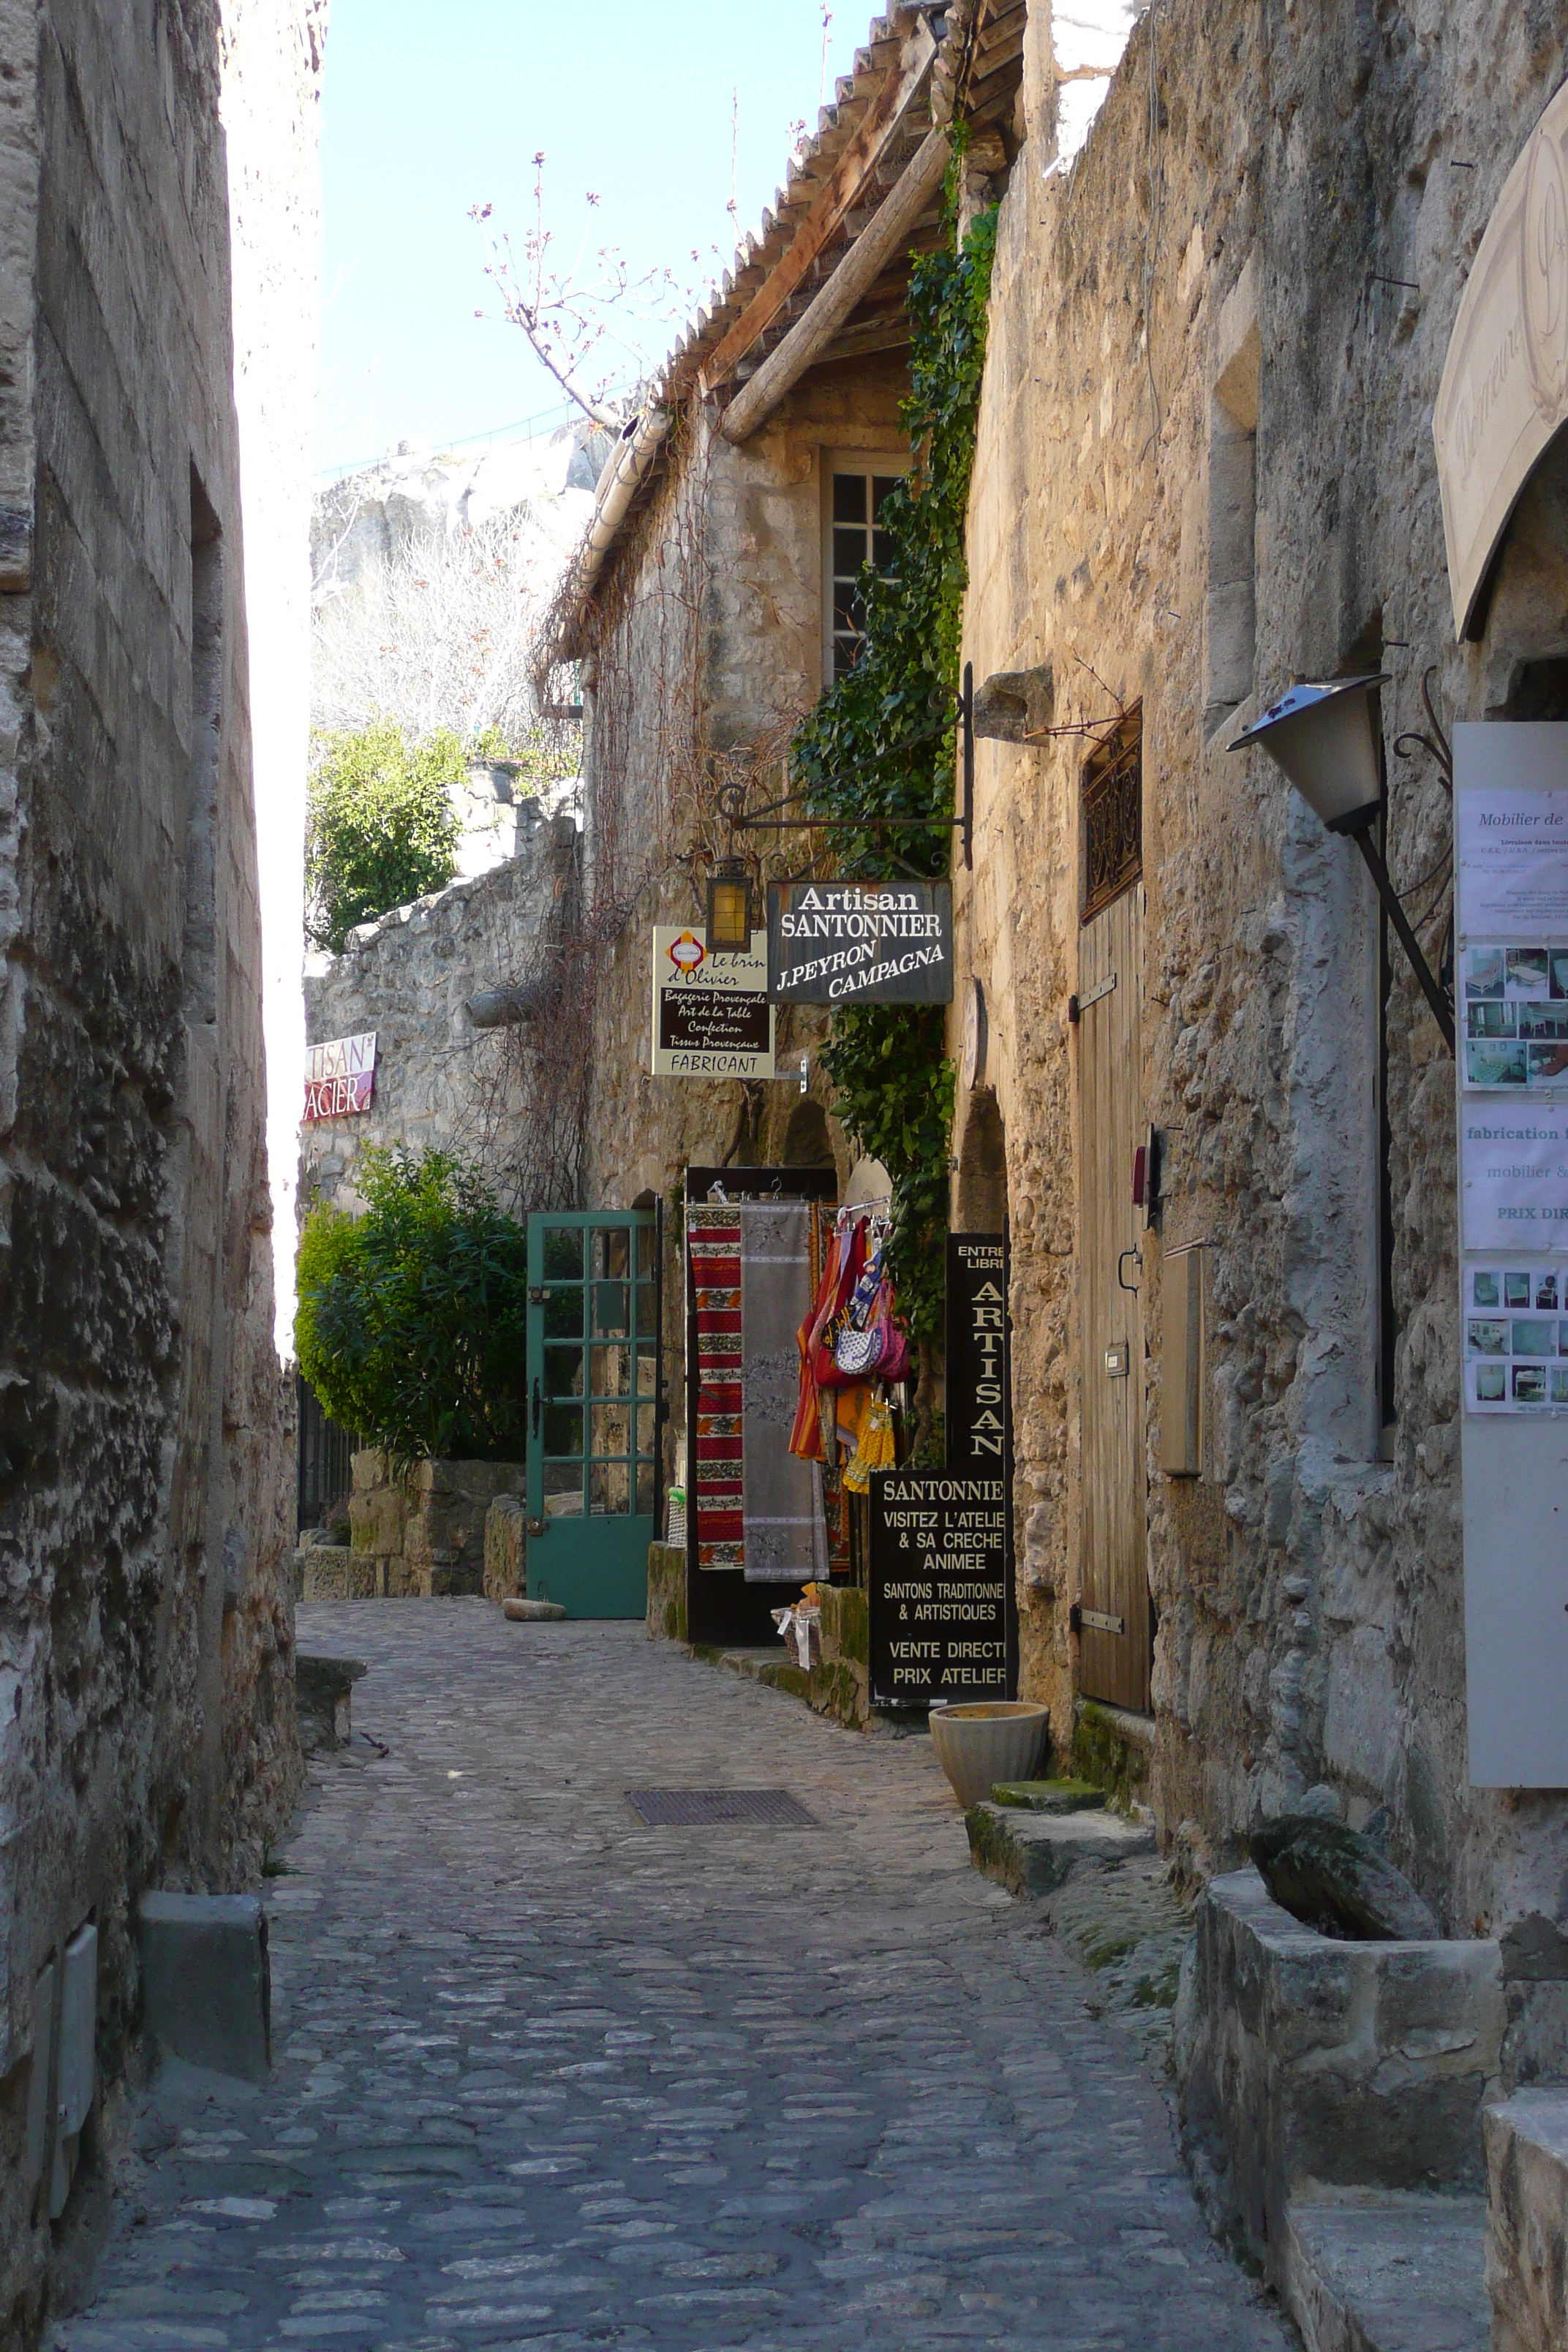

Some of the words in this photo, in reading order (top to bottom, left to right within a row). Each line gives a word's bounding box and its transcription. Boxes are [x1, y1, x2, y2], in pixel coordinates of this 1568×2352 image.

[1479, 813, 1540, 826] Mobilier
[1544, 813, 1563, 826] de
[798, 887, 919, 911] Artisan
[781, 914, 942, 938] SANTONNIER
[712, 952, 727, 968] Le
[731, 952, 766, 968] brin
[668, 967, 739, 986] d'Olivier
[828, 944, 944, 998] CAMPAGNA
[665, 989, 711, 1006] Bagagerie
[712, 991, 766, 1006] Provençale
[678, 1005, 697, 1017] Art
[698, 1006, 710, 1017] de
[711, 1006, 724, 1017] la
[726, 1006, 752, 1019] Table
[687, 1021, 743, 1036] Confection
[670, 1035, 700, 1047] Tissus
[702, 1036, 759, 1050] Provençaux
[308, 1036, 366, 1079] TISAN
[671, 1055, 758, 1073] FABRICANT
[304, 1077, 361, 1120] ACIER
[1467, 1126, 1559, 1139] fabrication
[1487, 1165, 1551, 1178] mobilier
[1497, 1207, 1537, 1219] PRIX
[970, 1281, 1003, 1455] ARTISAN
[883, 1512, 938, 1528] VISITEZ
[899, 1532, 909, 1548] &
[916, 1532, 936, 1548] SA
[943, 1532, 1003, 1548] CRECHE
[923, 1553, 986, 1569] ANIMEE
[883, 1583, 932, 1599] SANTONS
[937, 1583, 1006, 1599] TRADITIONNE
[899, 1604, 908, 1621] &
[914, 1604, 996, 1621] ARTISTIQUES
[889, 1642, 941, 1658] VENTE
[948, 1642, 1006, 1658] DIRECT
[893, 1667, 932, 1684] PRIX
